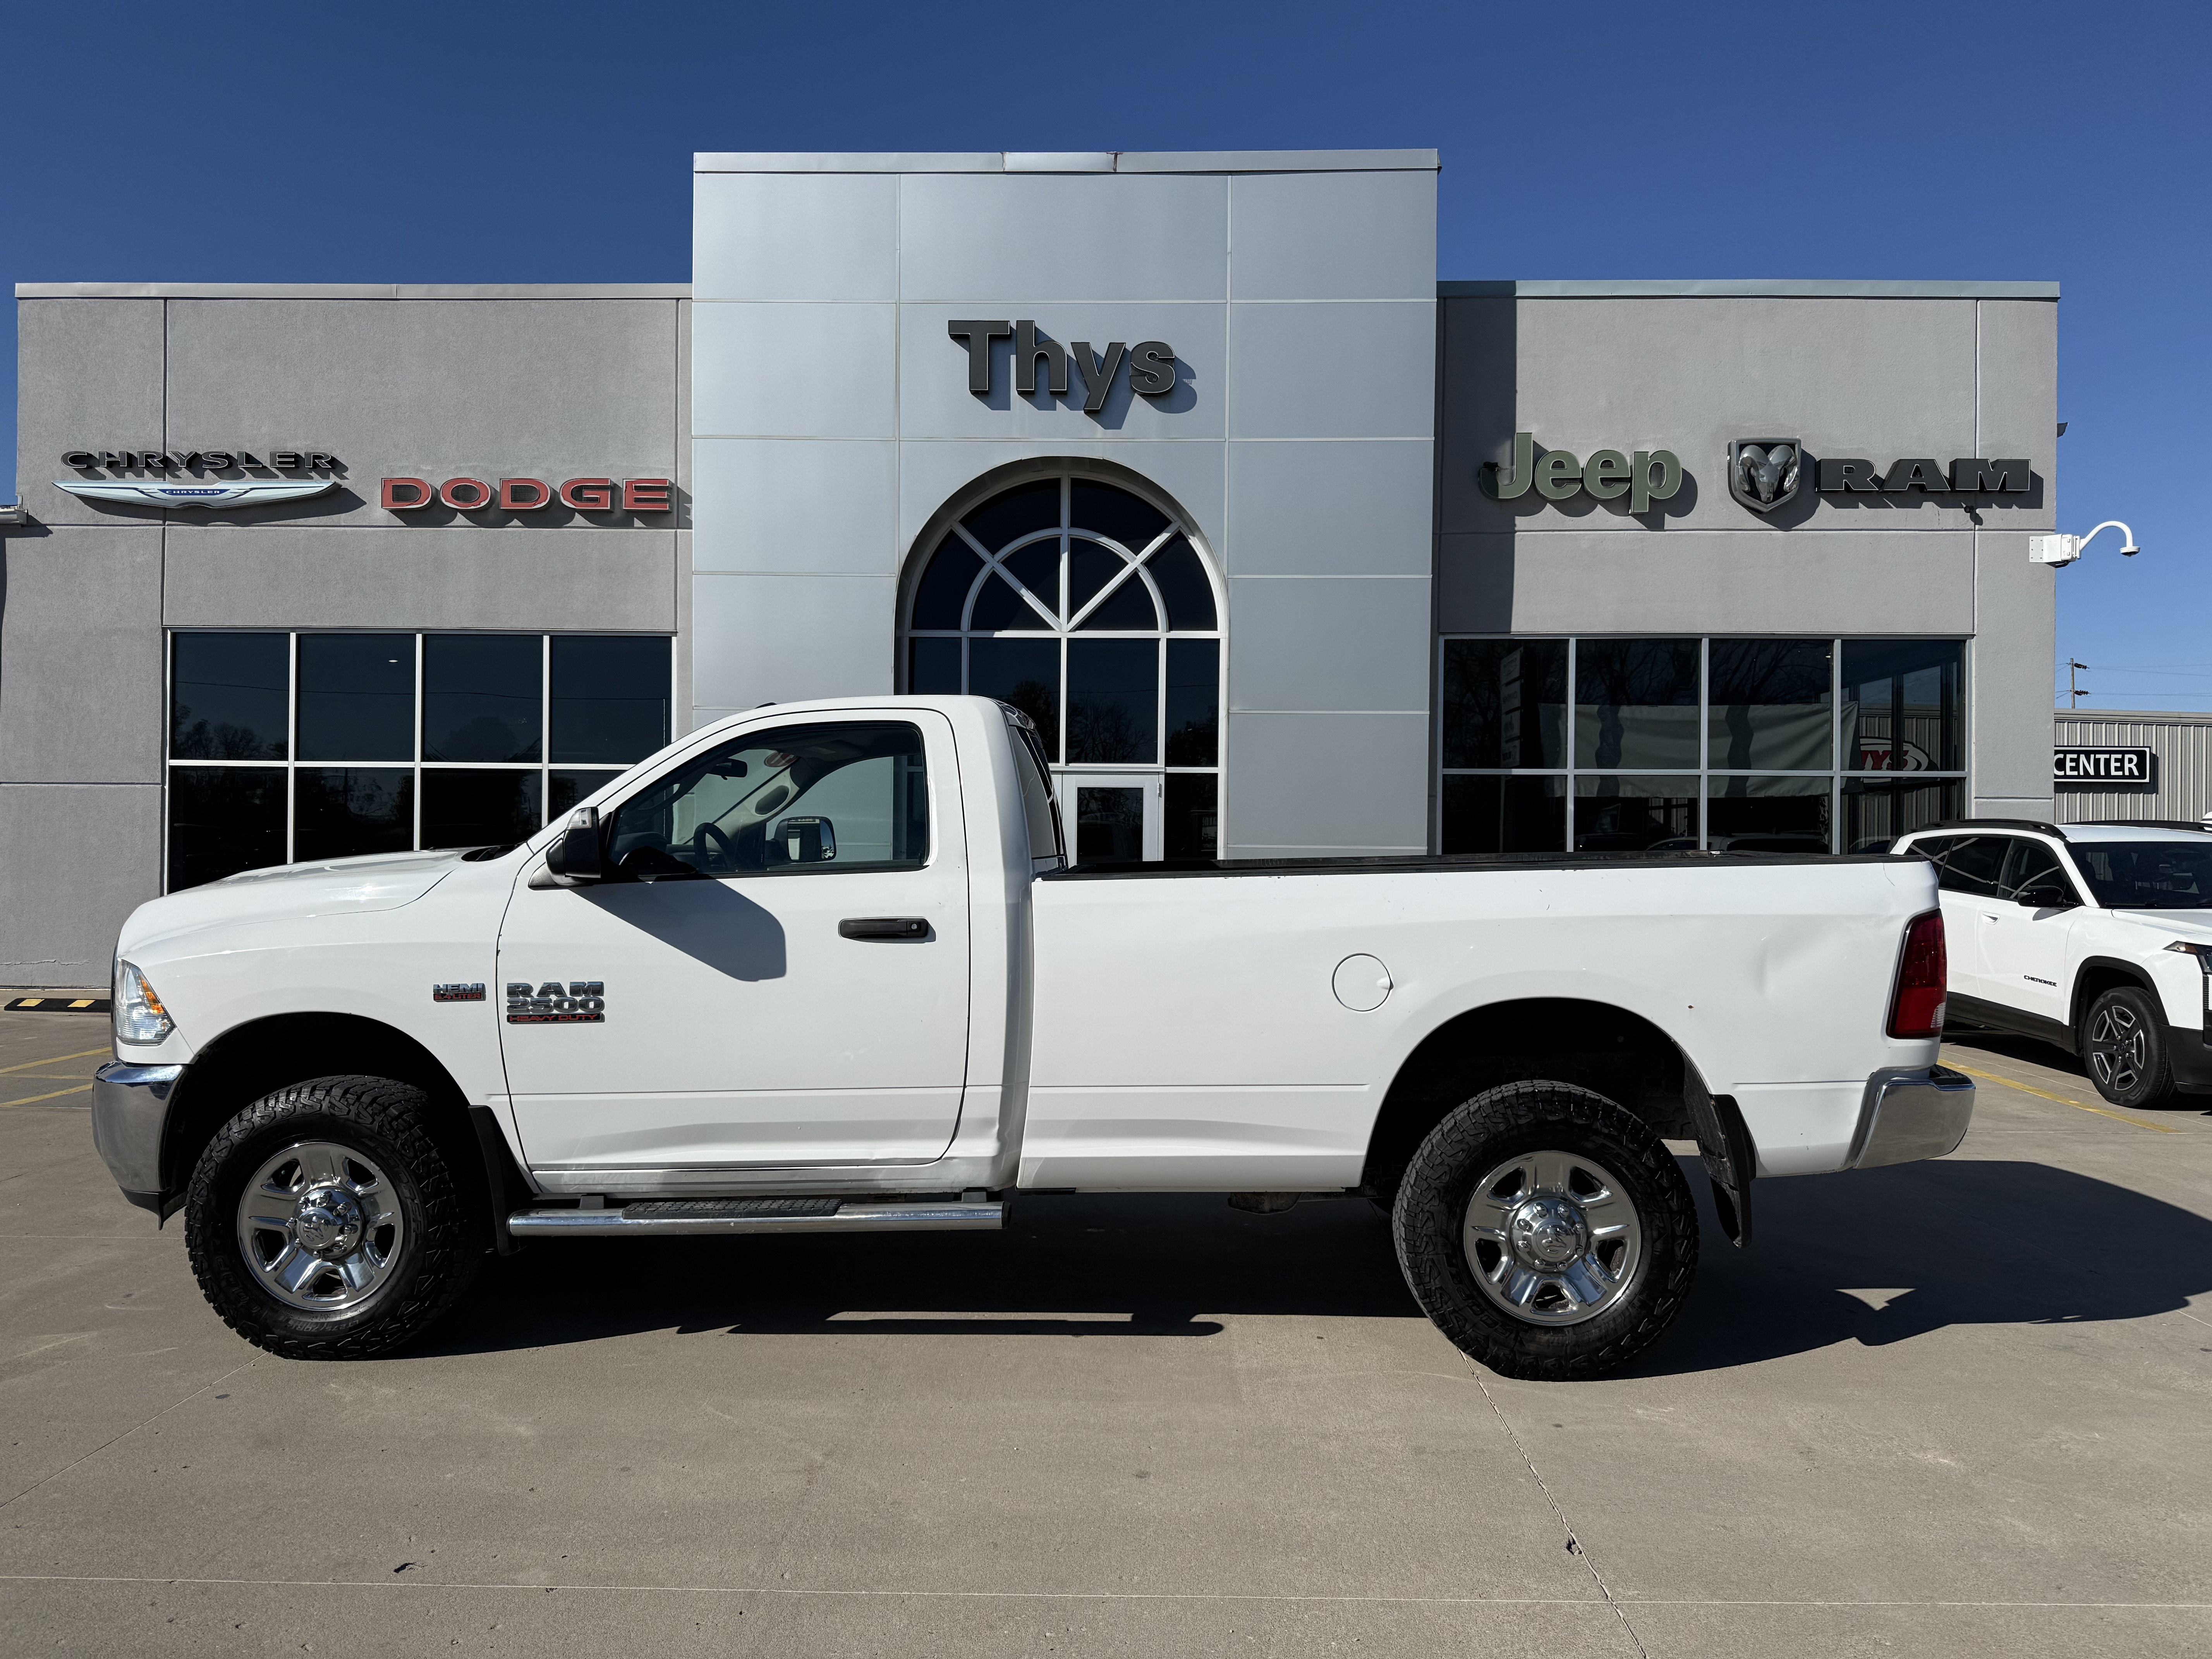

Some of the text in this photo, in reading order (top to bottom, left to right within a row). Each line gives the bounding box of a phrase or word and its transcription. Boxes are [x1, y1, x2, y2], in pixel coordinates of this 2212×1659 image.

[948, 320, 1176, 413] Thys
[60, 451, 332, 468] CHRYSLER
[1479, 432, 1682, 514] Jeep
[1815, 459, 2031, 492] RAM
[381, 477, 670, 512] DODGE
[2054, 754, 2139, 776] CENTER
[433, 983, 485, 993] HEMI
[507, 981, 604, 998] RAM
[2024, 975, 2057, 987] CHEROKEE
[507, 996, 605, 1013] 2500
